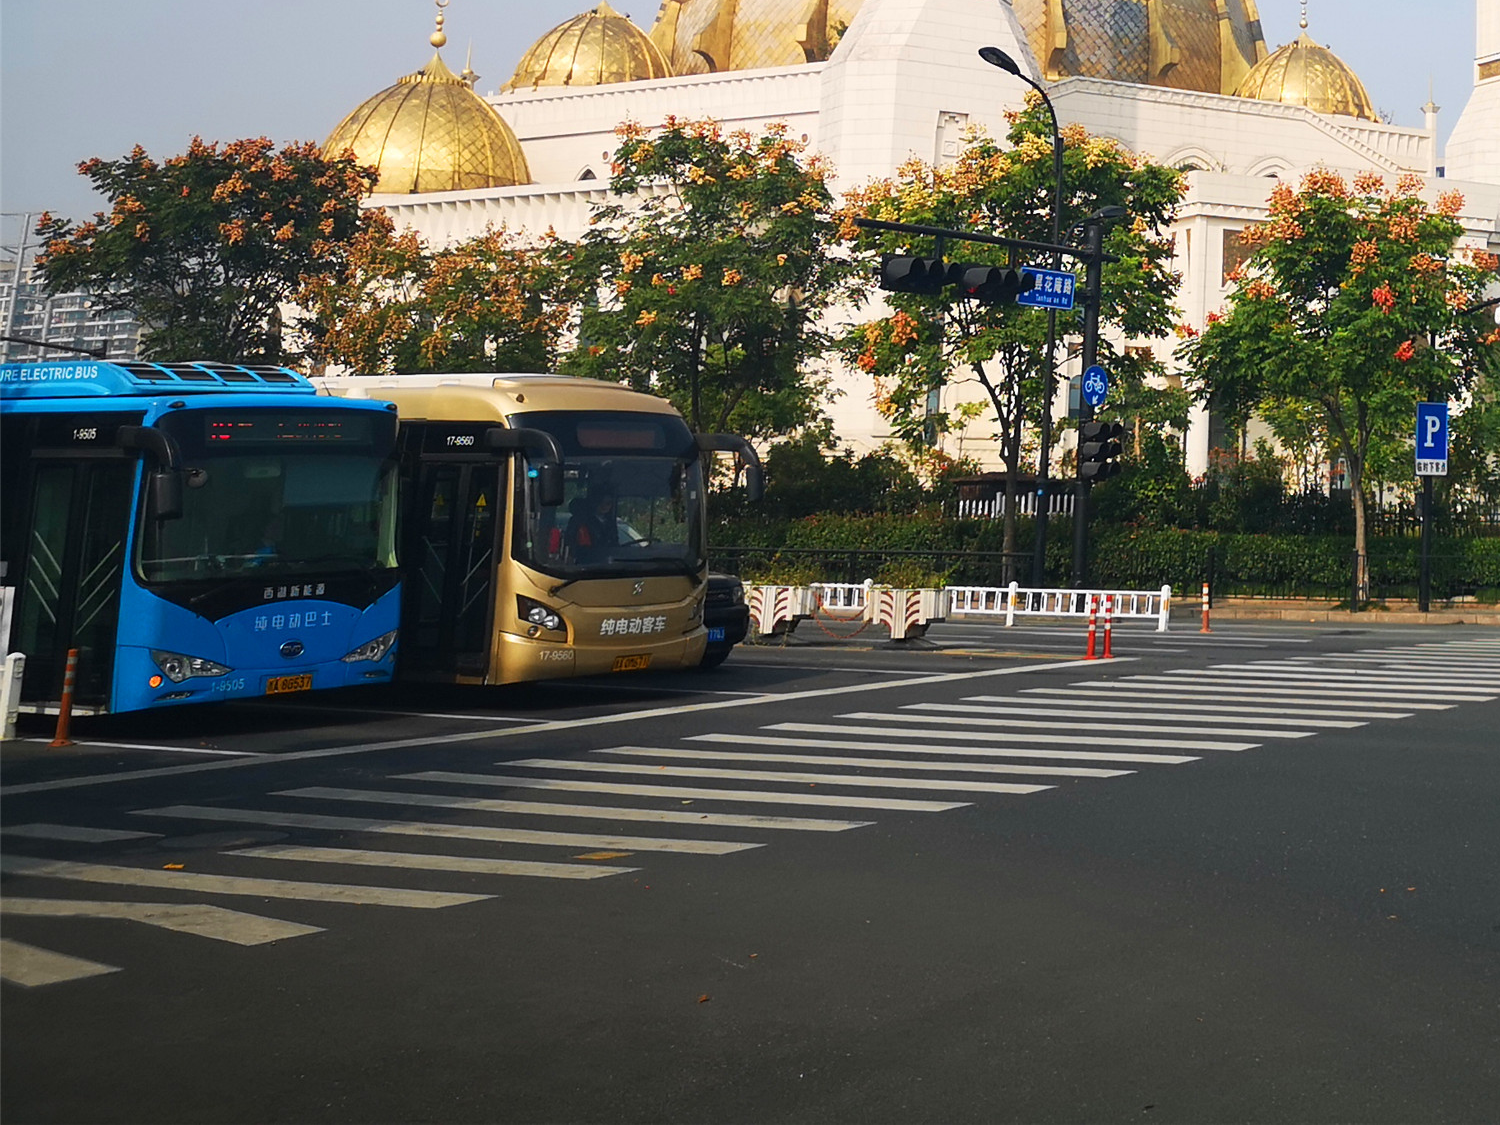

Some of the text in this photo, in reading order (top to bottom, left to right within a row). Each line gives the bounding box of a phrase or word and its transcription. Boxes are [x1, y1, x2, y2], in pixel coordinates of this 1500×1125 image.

[1034, 273, 1072, 295] 昙花庵路
[1061, 296, 1068, 305] Rd
[20, 366, 73, 381] ELECTRIC
[75, 365, 98, 379] BUS
[73, 427, 97, 440] 1-9505
[1424, 415, 1440, 447] P
[446, 435, 475, 446] 17-9560
[254, 610, 332, 632] 纯电动巴士
[600, 616, 666, 636] 纯电动客车
[539, 650, 574, 661] 17-9560
[211, 678, 245, 693] 1-9505
